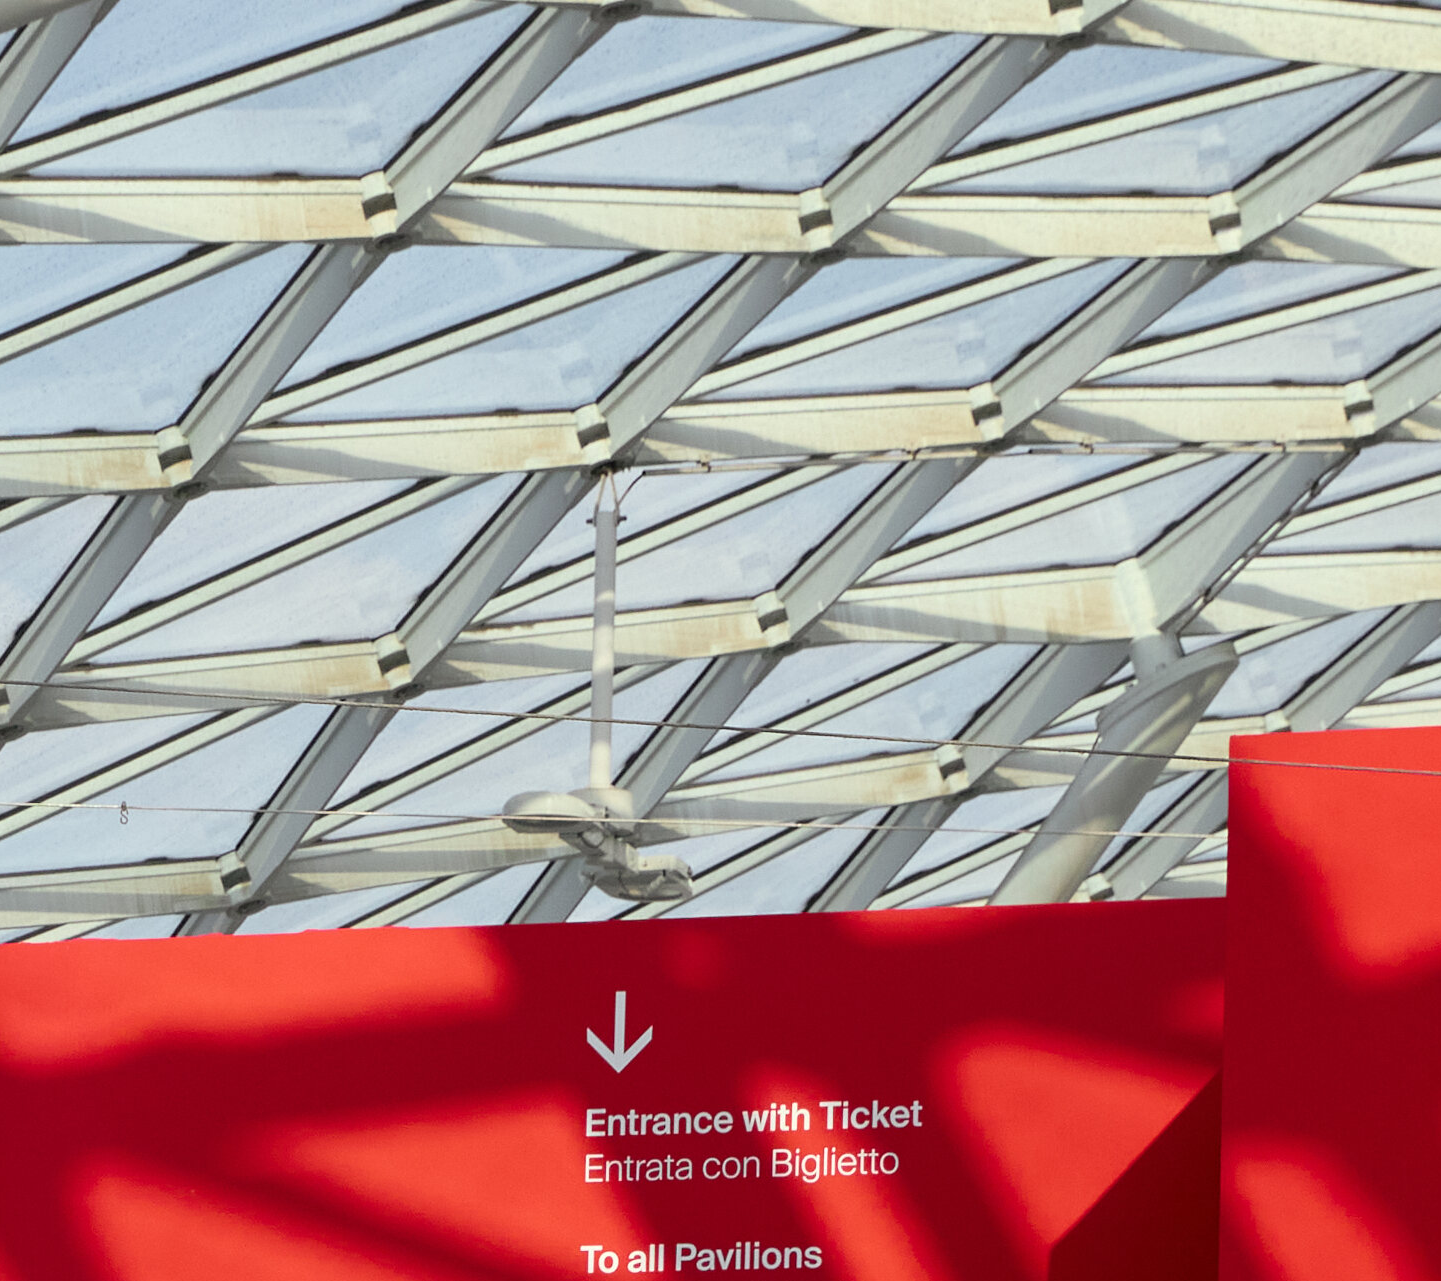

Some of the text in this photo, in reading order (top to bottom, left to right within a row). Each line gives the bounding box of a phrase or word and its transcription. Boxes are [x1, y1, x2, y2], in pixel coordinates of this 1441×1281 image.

[584, 1099, 924, 1138] Entrance with Ticket
[584, 1147, 900, 1184] Entrata con Biglietto
[579, 1241, 823, 1275] To all Pavilions
